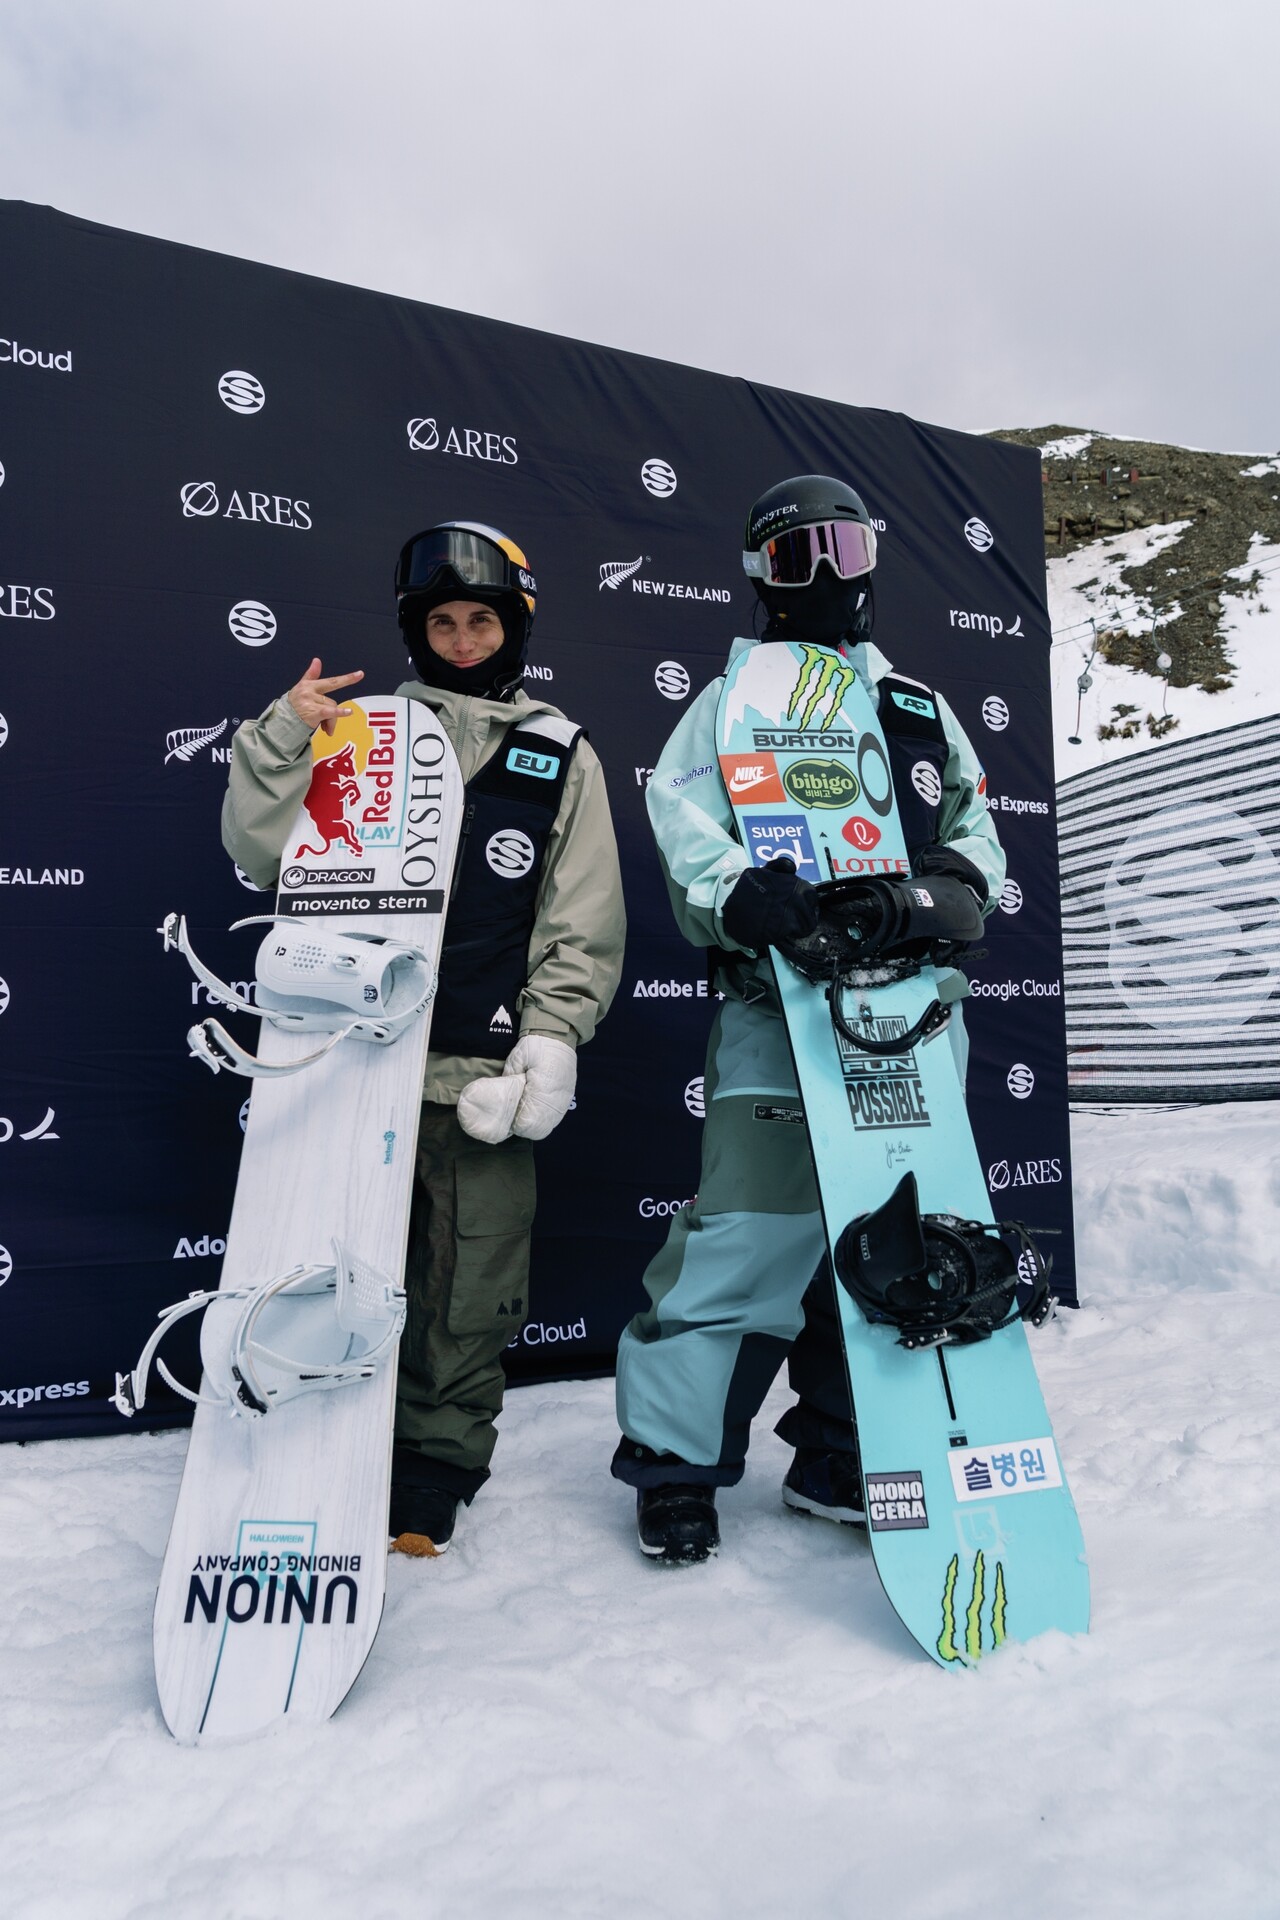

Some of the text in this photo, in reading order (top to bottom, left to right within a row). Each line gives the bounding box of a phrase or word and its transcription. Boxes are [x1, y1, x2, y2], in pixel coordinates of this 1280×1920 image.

[442, 426, 518, 465] ARES
[222, 489, 313, 530] ARES
[752, 504, 799, 534] MONSTER
[632, 579, 731, 603] NEW ZEALAND
[0, 584, 57, 621] ES
[949, 609, 1004, 639] ramp
[752, 734, 855, 748] BURTON
[212, 747, 233, 764] NE
[513, 753, 552, 774] EU
[362, 711, 397, 823] Red Bull
[670, 765, 714, 787] Shinhan
[734, 766, 765, 781] NIKE
[791, 772, 854, 795] bibigo
[805, 789, 832, 798] 비비고
[401, 733, 446, 888] OYSHO
[1000, 795, 1050, 816] Express
[751, 825, 804, 842] super
[0, 867, 85, 885] EALAND
[306, 870, 373, 883] DRAGON
[832, 858, 911, 874] LOTTE
[291, 895, 428, 912] movento stern
[632, 979, 694, 998] Adobe
[968, 979, 1061, 1002] Google Cloud
[842, 1059, 918, 1074] FUN
[845, 1080, 930, 1126] POSSIBLE
[1012, 1158, 1063, 1187] ARES
[172, 1233, 229, 1259] Ado
[523, 1317, 587, 1345] Cloud
[0, 1380, 90, 1409] xpress
[963, 1448, 1047, 1492] 솔병원
[867, 1481, 924, 1502] MONO
[870, 1500, 927, 1521] CERA
[249, 1533, 305, 1543] HALLOWEEN
[192, 1555, 281, 1572] COMPANY
[287, 1555, 362, 1572] BINDING
[184, 1574, 359, 1624] UNION
